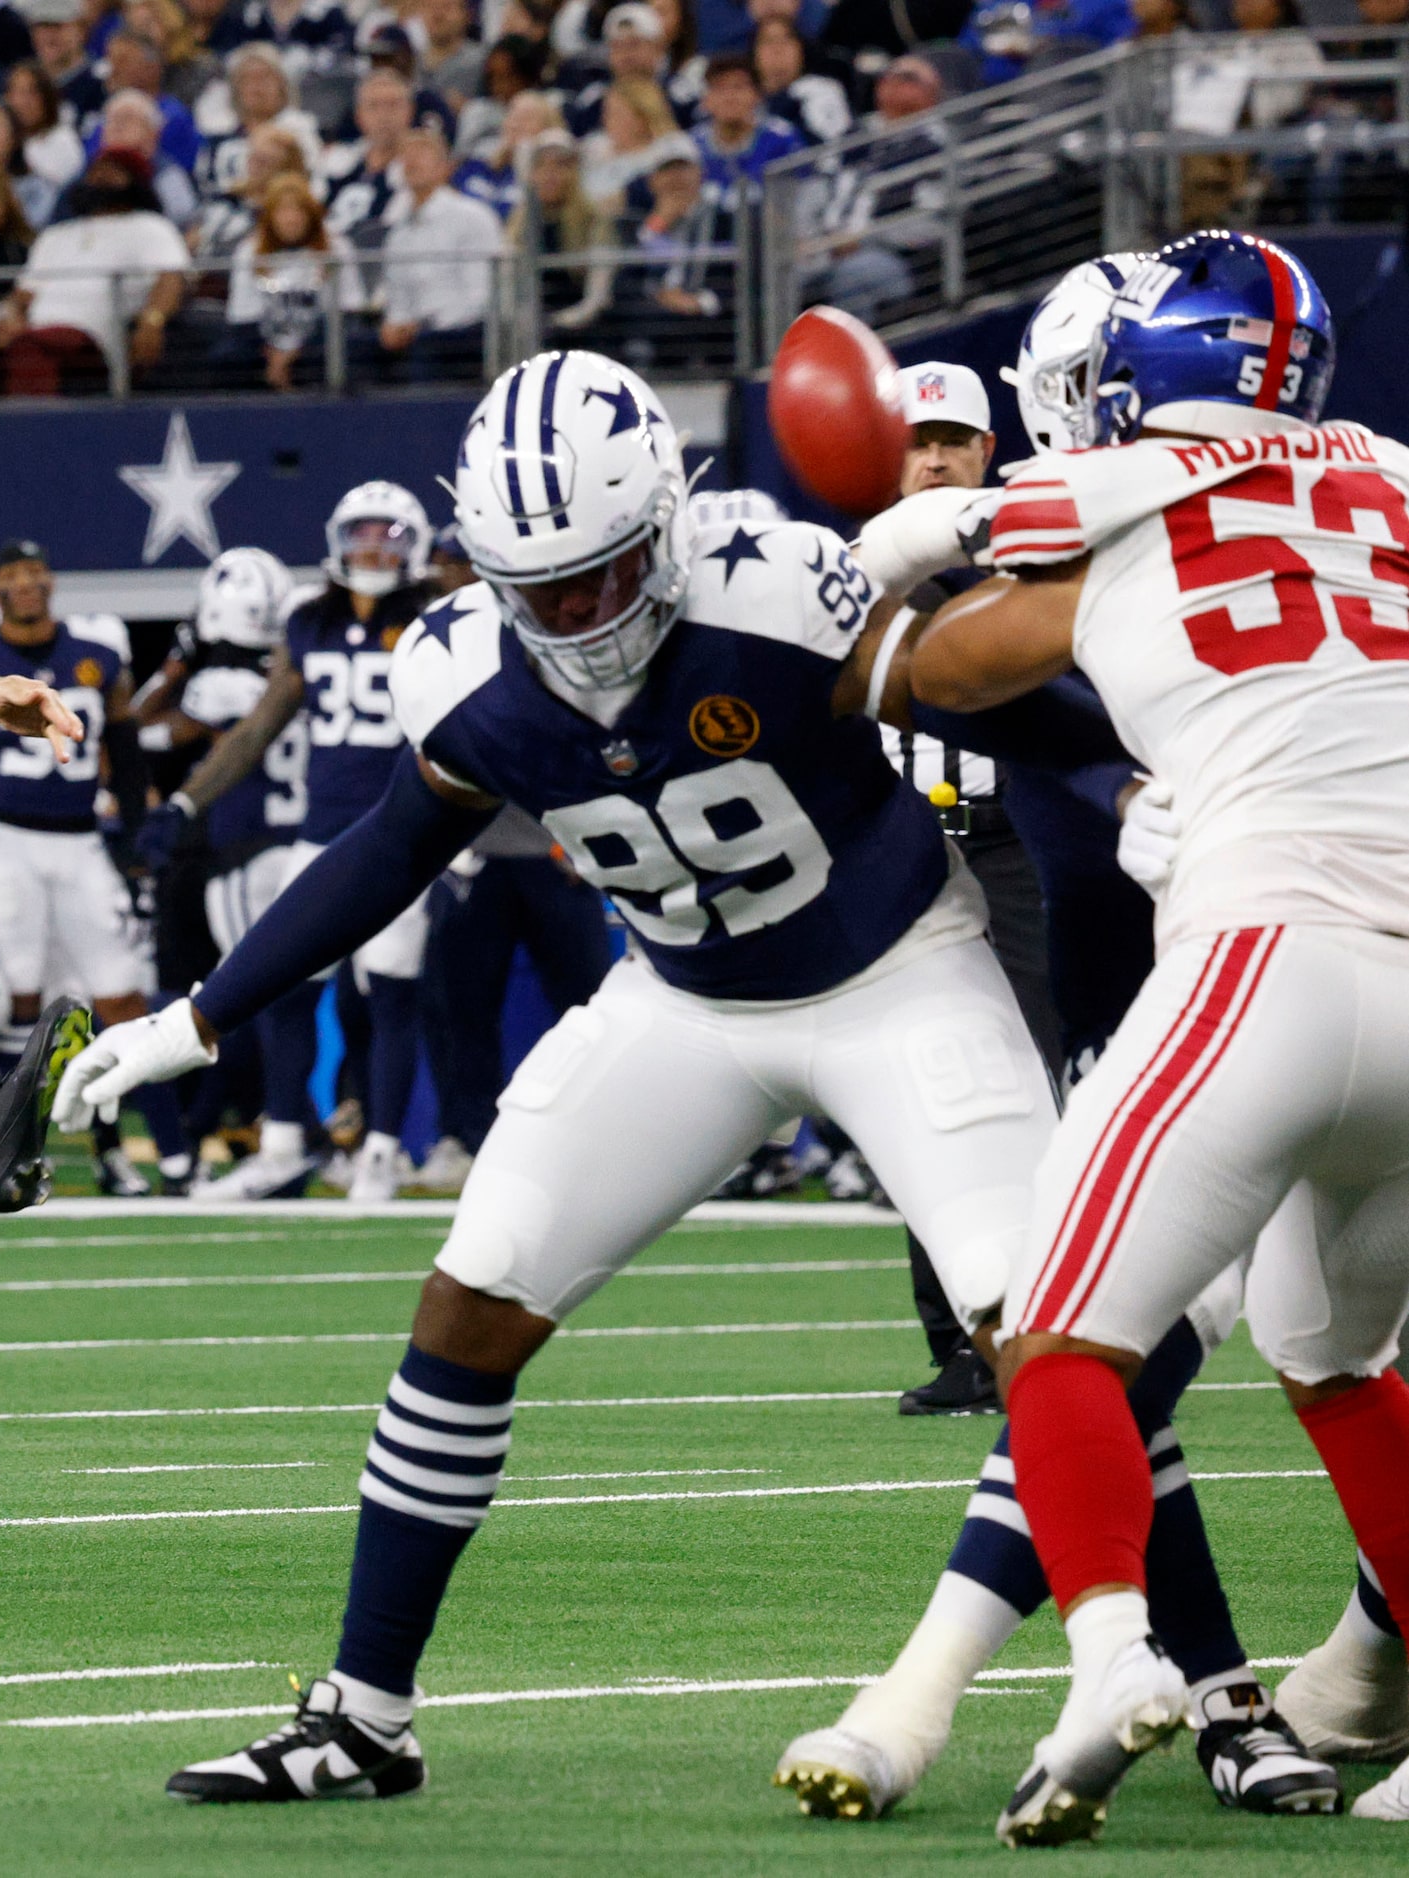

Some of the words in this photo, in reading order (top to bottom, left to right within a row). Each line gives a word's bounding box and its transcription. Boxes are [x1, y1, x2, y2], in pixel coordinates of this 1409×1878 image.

[1237, 355, 1303, 404] 53
[1163, 462, 1409, 677] 53
[302, 652, 403, 748] 35
[542, 757, 834, 945] 99
